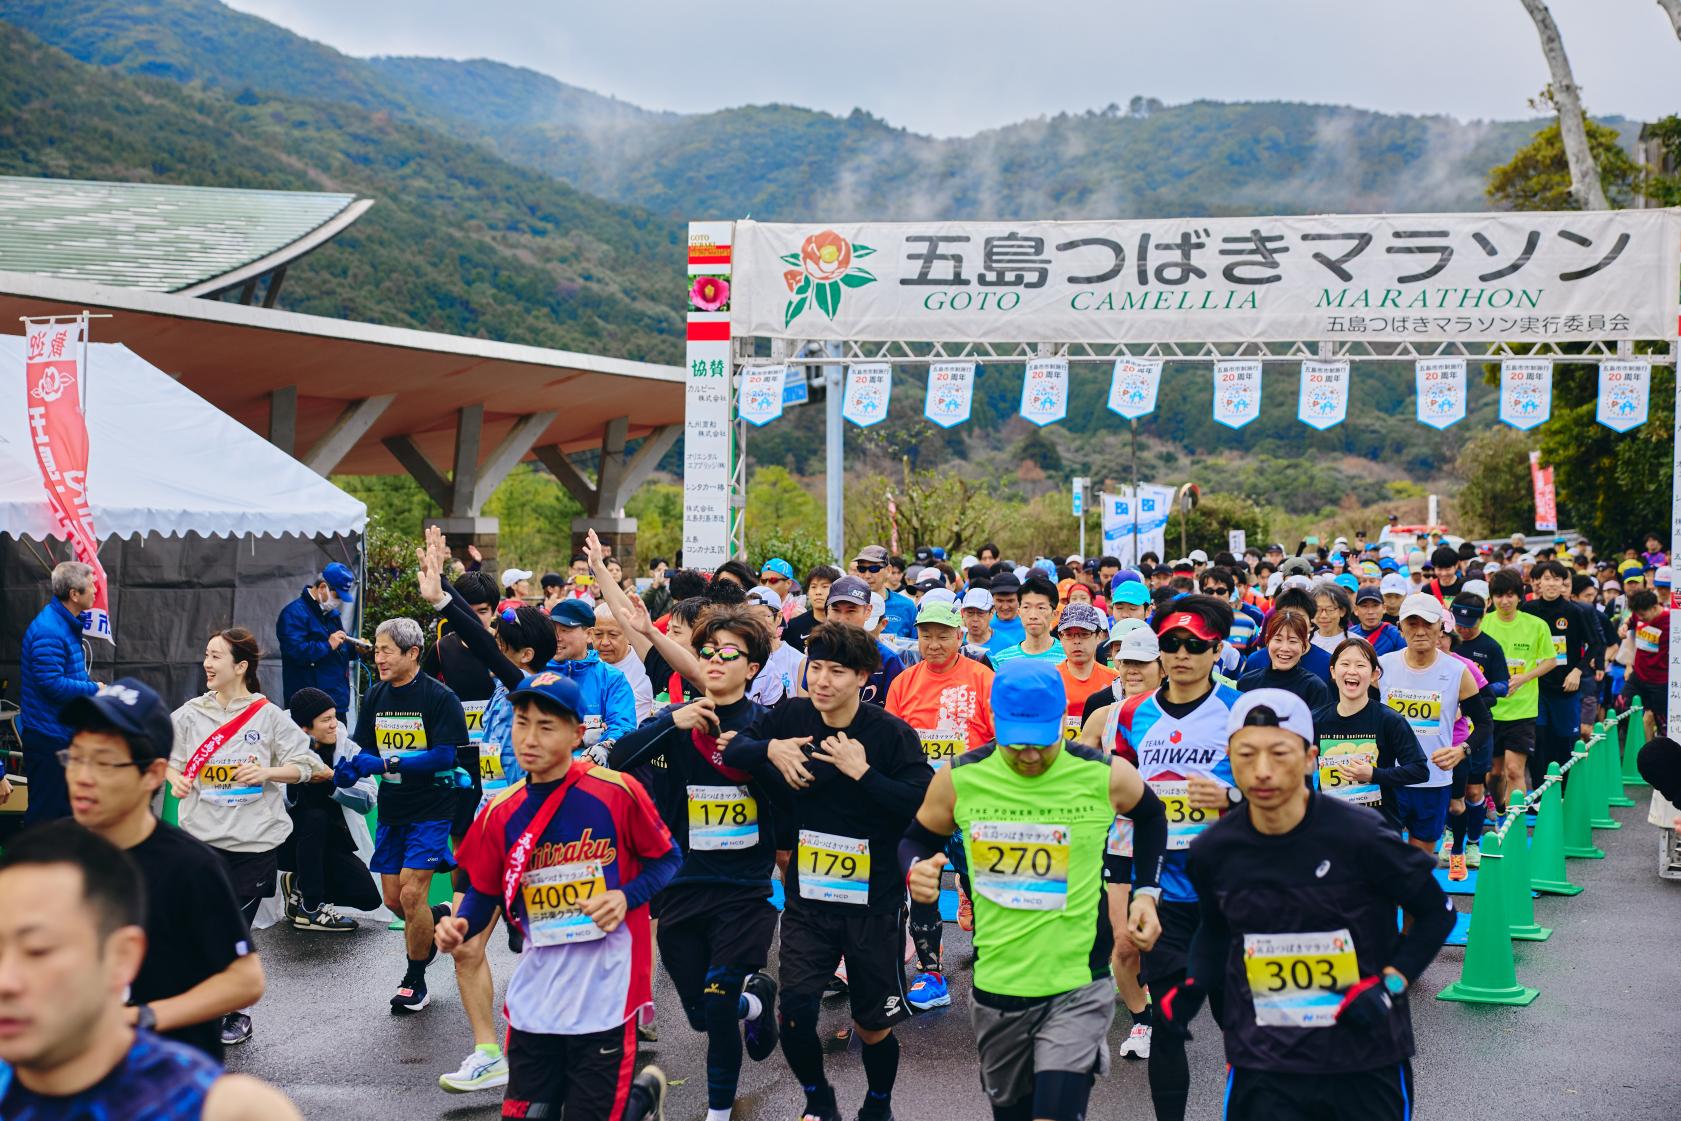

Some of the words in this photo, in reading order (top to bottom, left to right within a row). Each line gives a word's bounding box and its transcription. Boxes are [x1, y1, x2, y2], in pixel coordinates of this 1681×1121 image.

[900, 230, 1631, 289] 五島つばきマラソン
[923, 290, 1021, 312] GOTO
[1070, 289, 1259, 312] CAMELLIA
[1314, 287, 1544, 309] MARATHON
[1326, 314, 1631, 334] 五島つばきマラソン実行委員会
[691, 359, 725, 378] 協賛
[1396, 702, 1432, 719] 260
[382, 731, 417, 750] 402
[1145, 739, 1165, 747] TEAM
[1143, 748, 1217, 765] TAIWAN
[700, 803, 747, 826] 178
[969, 807, 988, 815] THE
[994, 808, 1033, 816] POWER
[1039, 808, 1052, 816] OF
[1060, 805, 1095, 814] THREE
[810, 851, 857, 879] 179
[987, 846, 1052, 877] 270
[531, 880, 597, 910] 4007
[1265, 959, 1338, 992] 303
